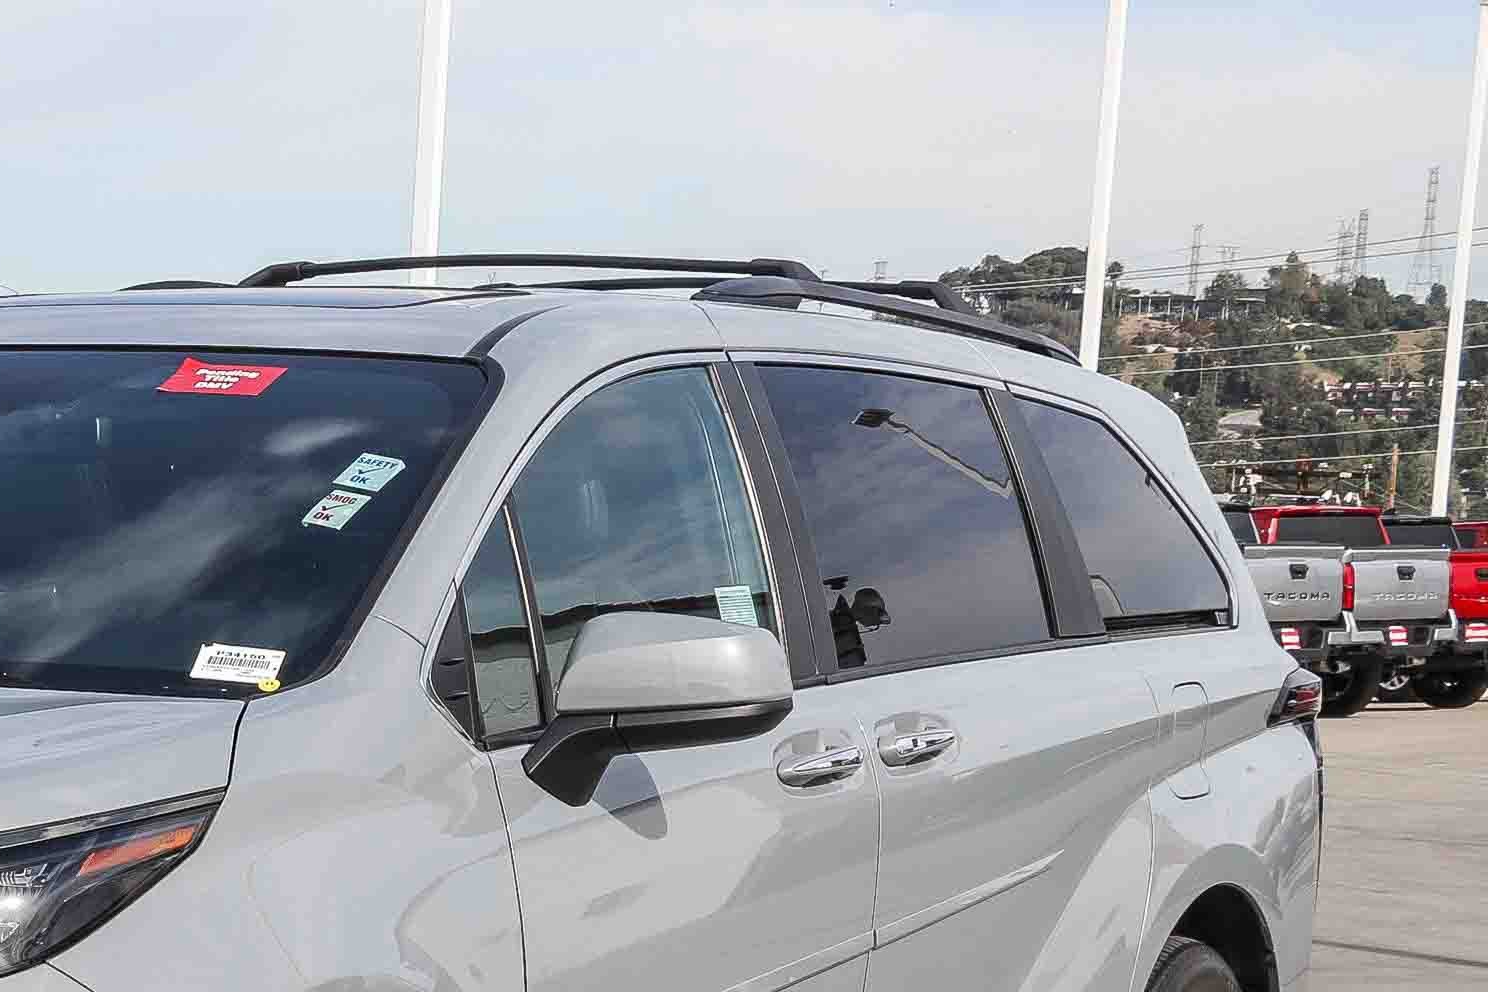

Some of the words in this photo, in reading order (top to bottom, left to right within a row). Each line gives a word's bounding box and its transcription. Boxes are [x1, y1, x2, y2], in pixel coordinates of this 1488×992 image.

[357, 457, 399, 469] SAFETY
[350, 475, 370, 485] OK
[313, 511, 334, 522] OK
[1263, 591, 1331, 601] TACOMA
